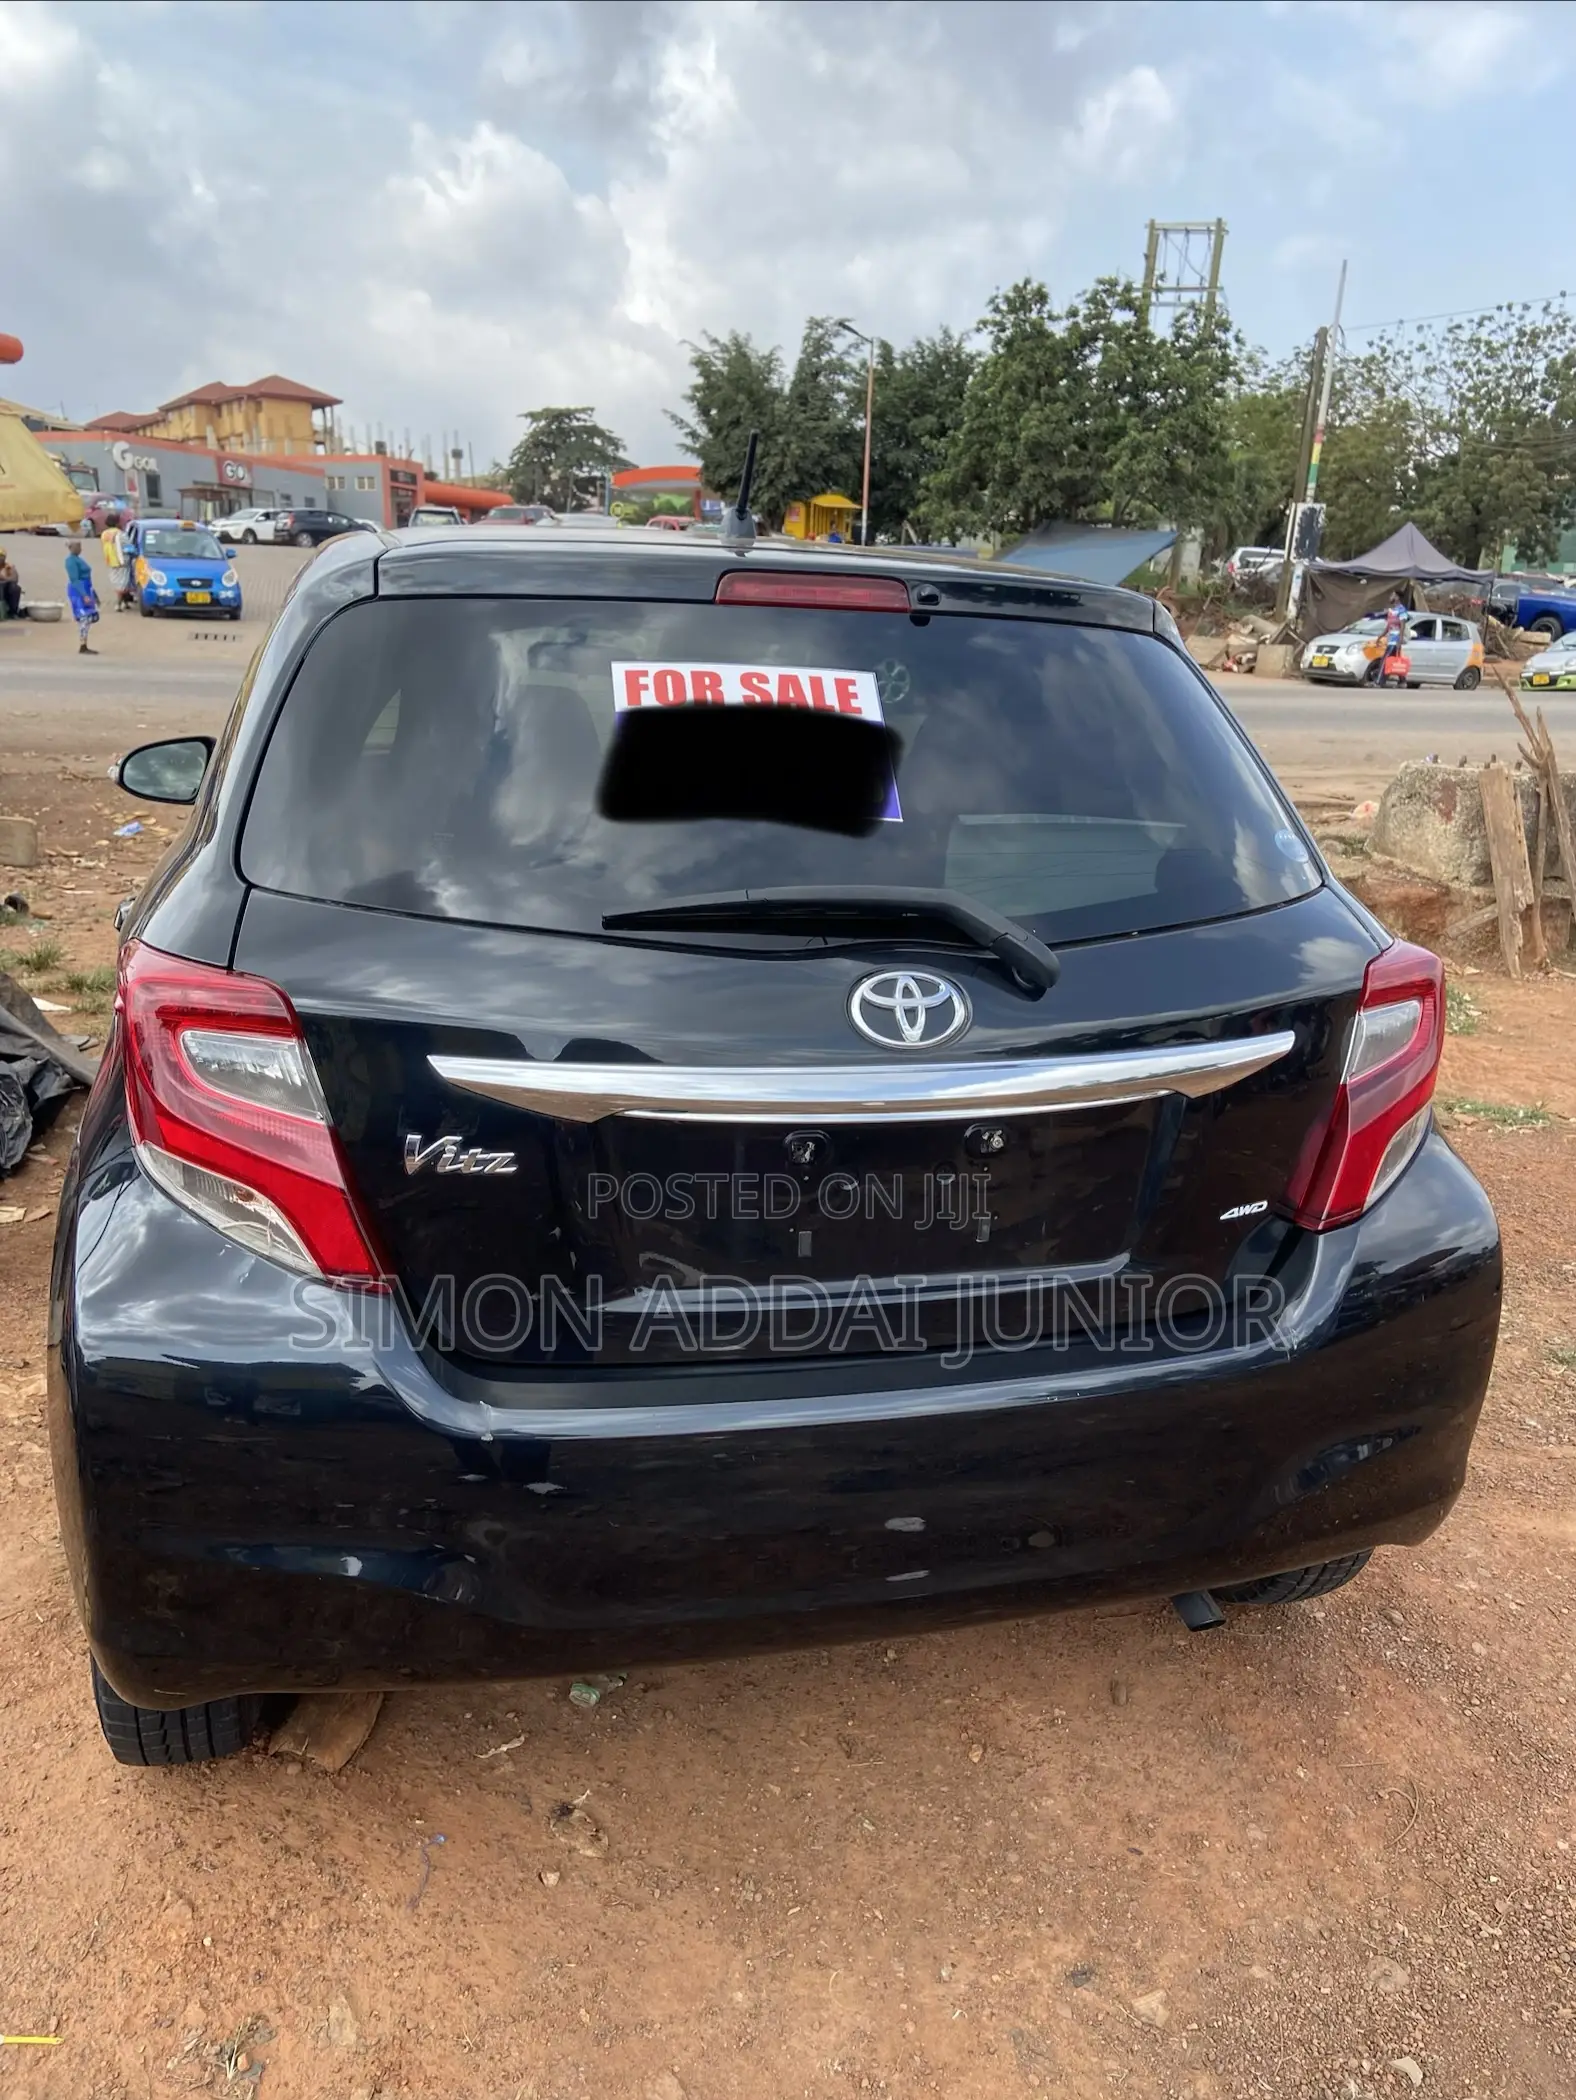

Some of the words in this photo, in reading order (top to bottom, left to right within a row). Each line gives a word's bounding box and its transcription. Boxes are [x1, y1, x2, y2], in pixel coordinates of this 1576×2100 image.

[624, 669, 725, 707] FOR
[739, 671, 863, 715] SALE
[403, 1133, 519, 1176] Vitz
